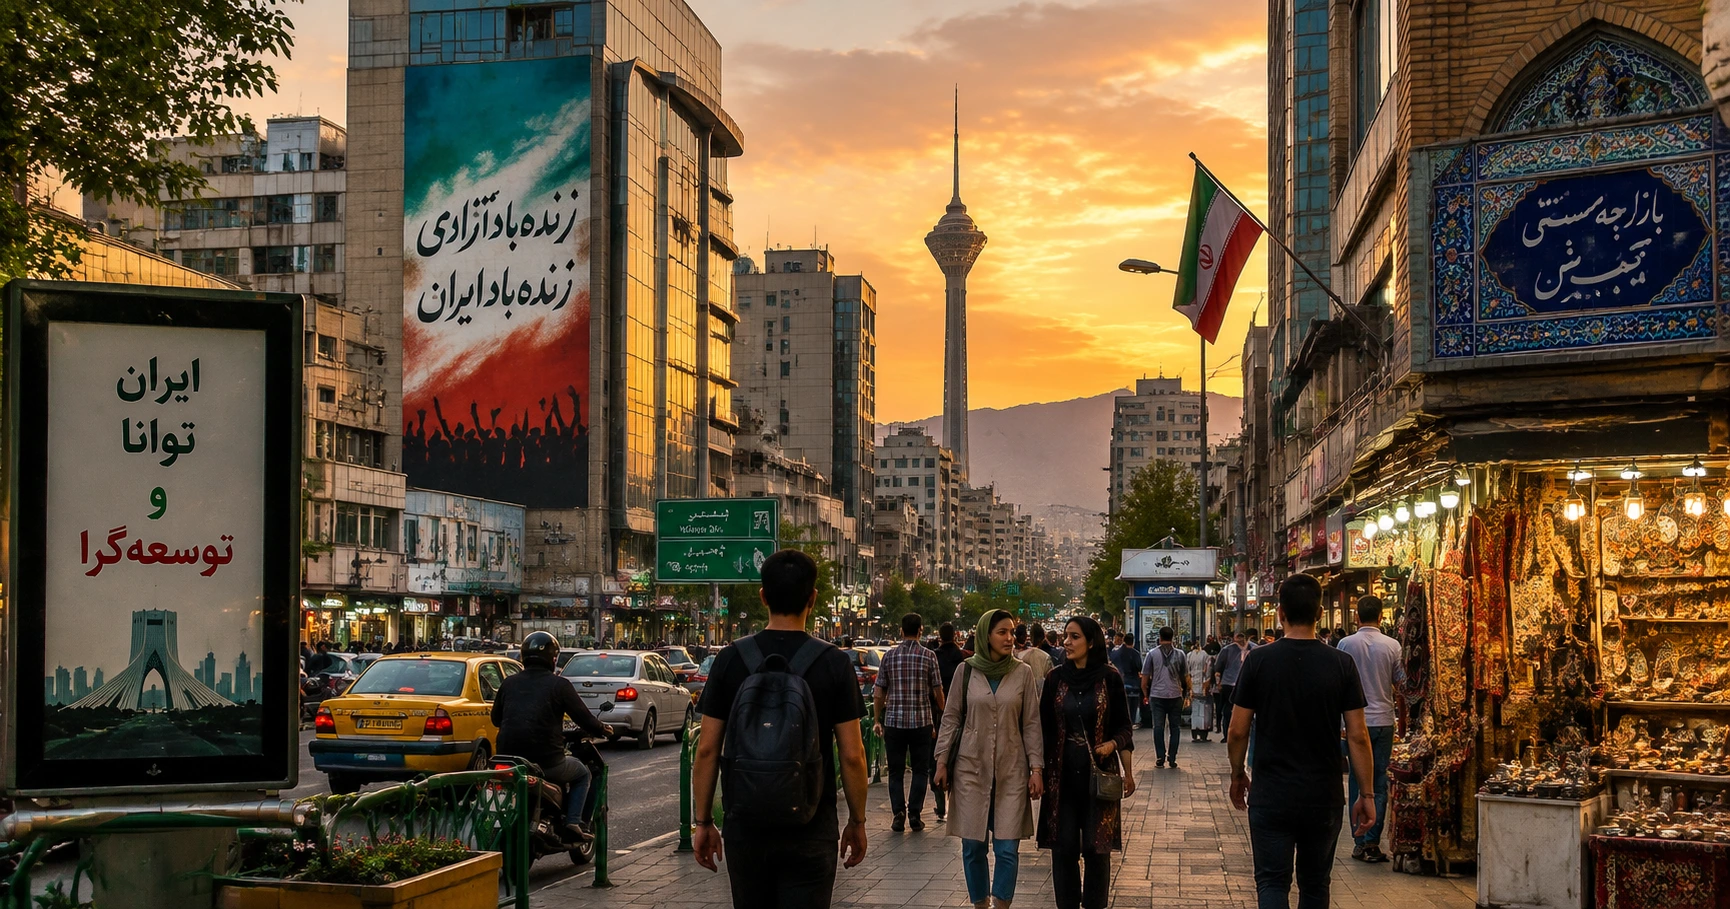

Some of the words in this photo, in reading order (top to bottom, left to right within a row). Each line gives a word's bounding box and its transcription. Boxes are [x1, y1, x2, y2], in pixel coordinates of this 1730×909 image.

[416, 189, 500, 258] آزادی
[487, 200, 519, 252] باد
[519, 188, 579, 245] زنده
[417, 267, 485, 326] ایران
[482, 266, 515, 320] باد
[517, 258, 576, 311] زنده
[116, 355, 200, 405] ایران
[121, 417, 196, 468] توانا
[146, 486, 168, 520] و
